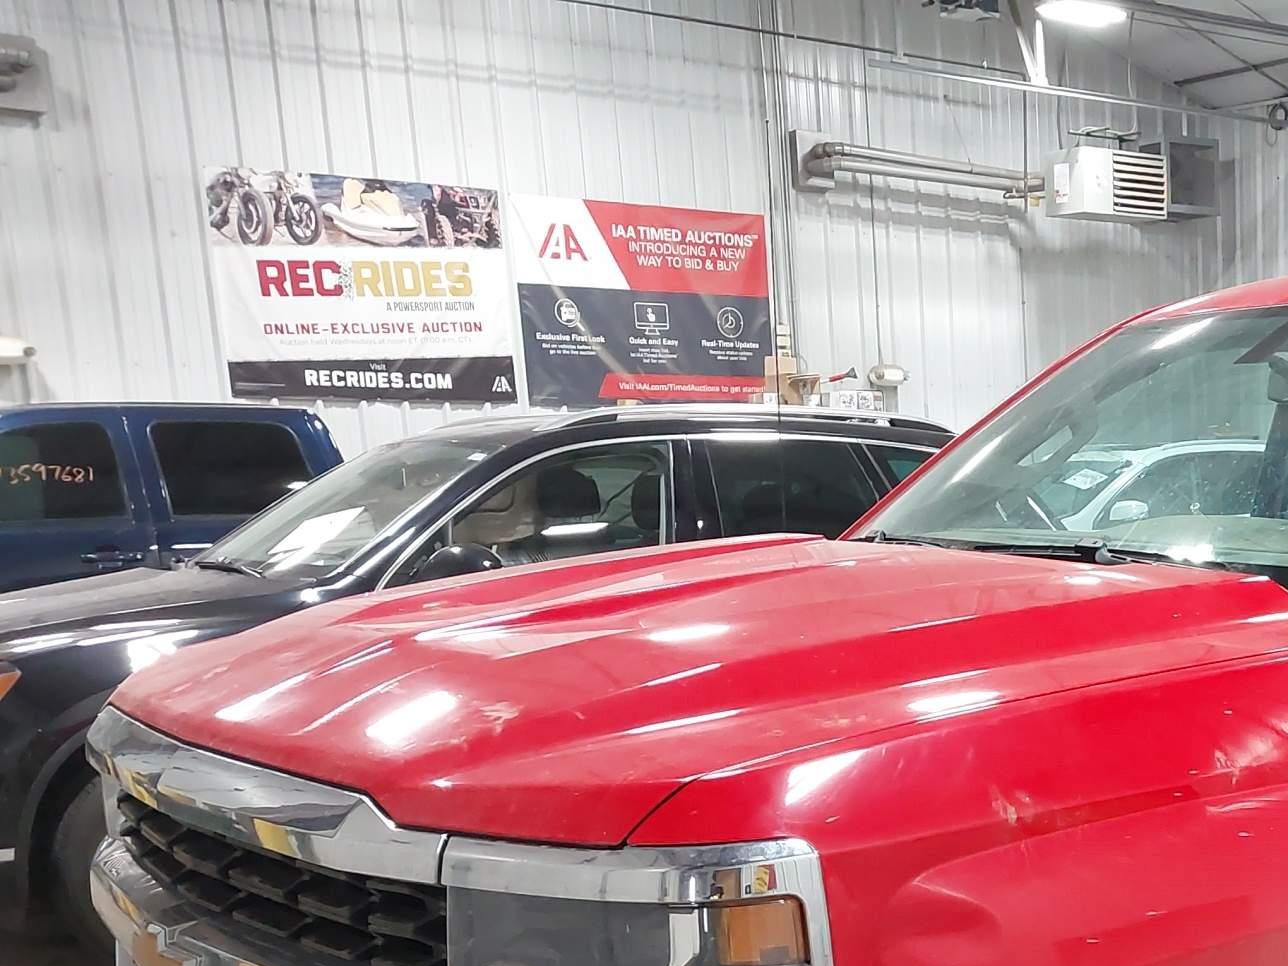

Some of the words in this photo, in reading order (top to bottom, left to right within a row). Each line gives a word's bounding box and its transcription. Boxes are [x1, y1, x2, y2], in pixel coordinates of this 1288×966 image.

[611, 223, 636, 239] IAA
[637, 226, 681, 241] TIMED
[628, 241, 706, 257] INTRODUCING
[709, 246, 717, 258] A
[720, 248, 745, 260] NEW
[637, 255, 662, 268] WAY
[665, 256, 681, 268] TO
[684, 258, 702, 270] BID
[705, 259, 714, 271] &
[717, 260, 739, 272] BUY
[256, 260, 343, 297] REC
[352, 261, 473, 297] RIDES
[386, 302, 392, 311] A
[394, 301, 443, 312] POWERSPORT
[445, 301, 475, 311] AUCTION
[263, 322, 415, 335] ONLINE-EXCLUSIVE
[422, 321, 483, 334] AUCTION
[535, 332, 570, 342] Exclusive
[571, 333, 587, 342] First
[629, 336, 647, 344] Quick
[662, 338, 679, 347] Easy
[701, 339, 734, 348] Real-Time
[735, 341, 759, 349] Updates
[370, 363, 386, 371] Visit
[305, 369, 453, 390] RECRIDES.COM
[618, 382, 634, 390] Visit
[730, 386, 741, 394] get
[0, 463, 94, 484] 3597681
